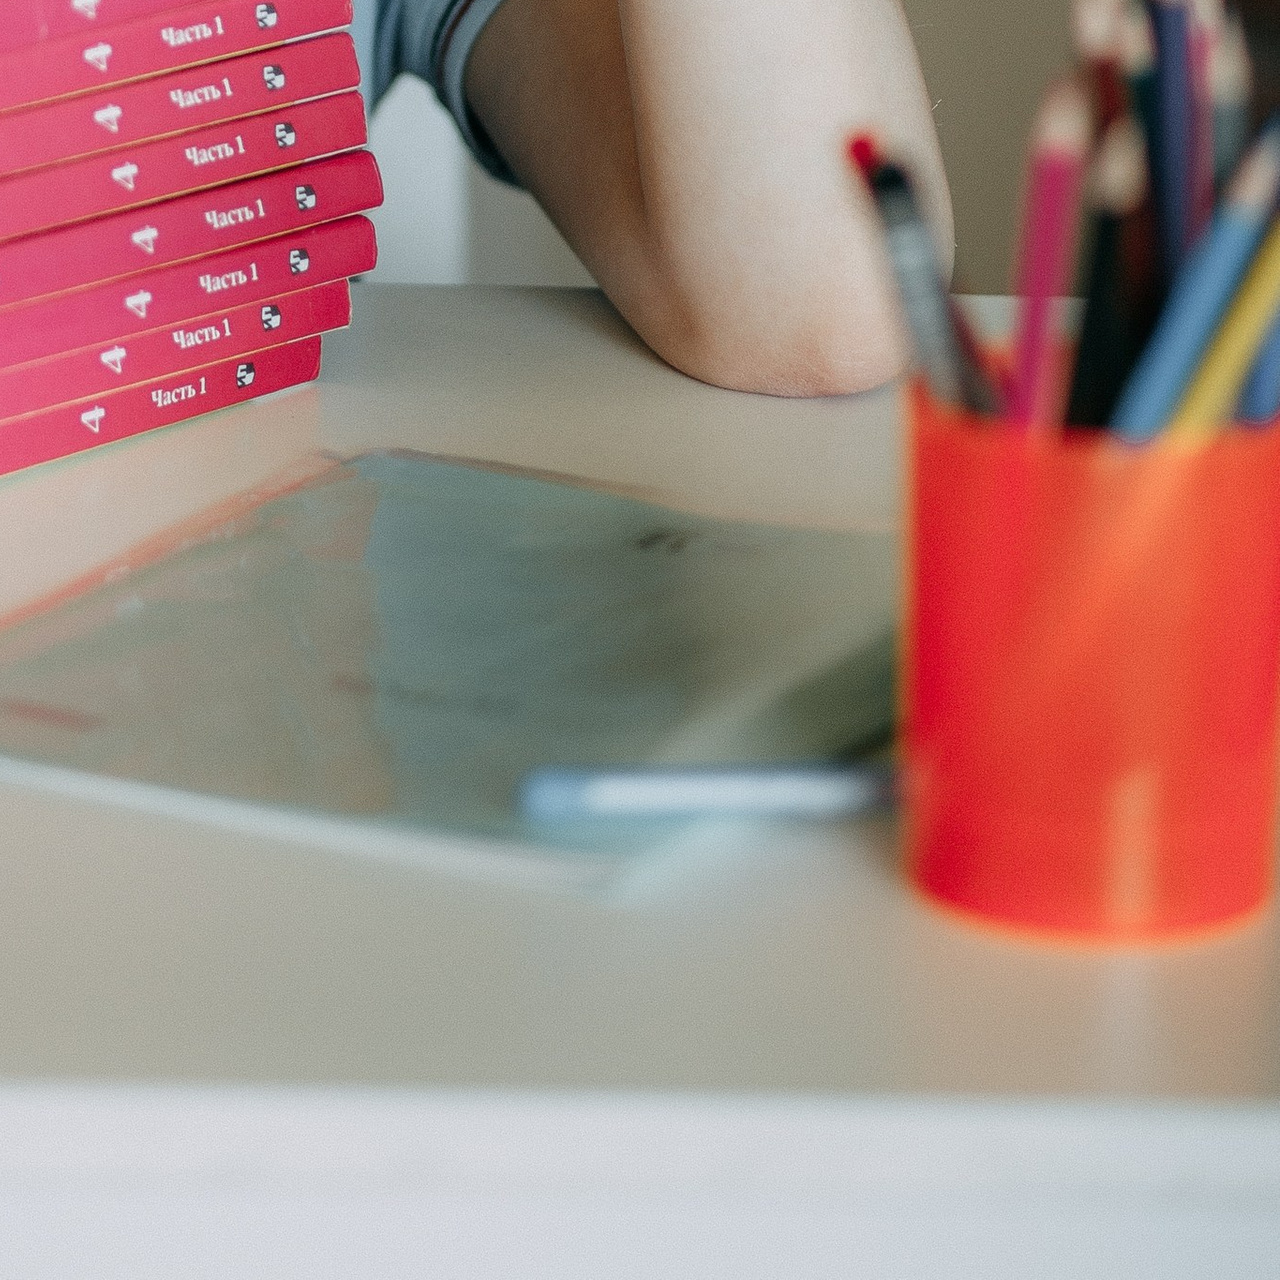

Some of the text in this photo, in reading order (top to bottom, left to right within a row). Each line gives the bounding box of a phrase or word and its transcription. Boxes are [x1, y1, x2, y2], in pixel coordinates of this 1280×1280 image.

[160, 23, 213, 47] Часть
[214, 16, 224, 35] 1
[169, 85, 222, 109] Часть
[223, 78, 233, 97] 1
[185, 143, 234, 166] Часть
[235, 136, 245, 155] 1
[205, 206, 254, 229] Часть
[255, 199, 265, 218] 1
[199, 270, 247, 293] Часть
[248, 263, 258, 282] 1
[172, 327, 220, 349] Часть
[221, 320, 231, 339] 1
[151, 384, 195, 407] Часть
[196, 377, 206, 396] 1
